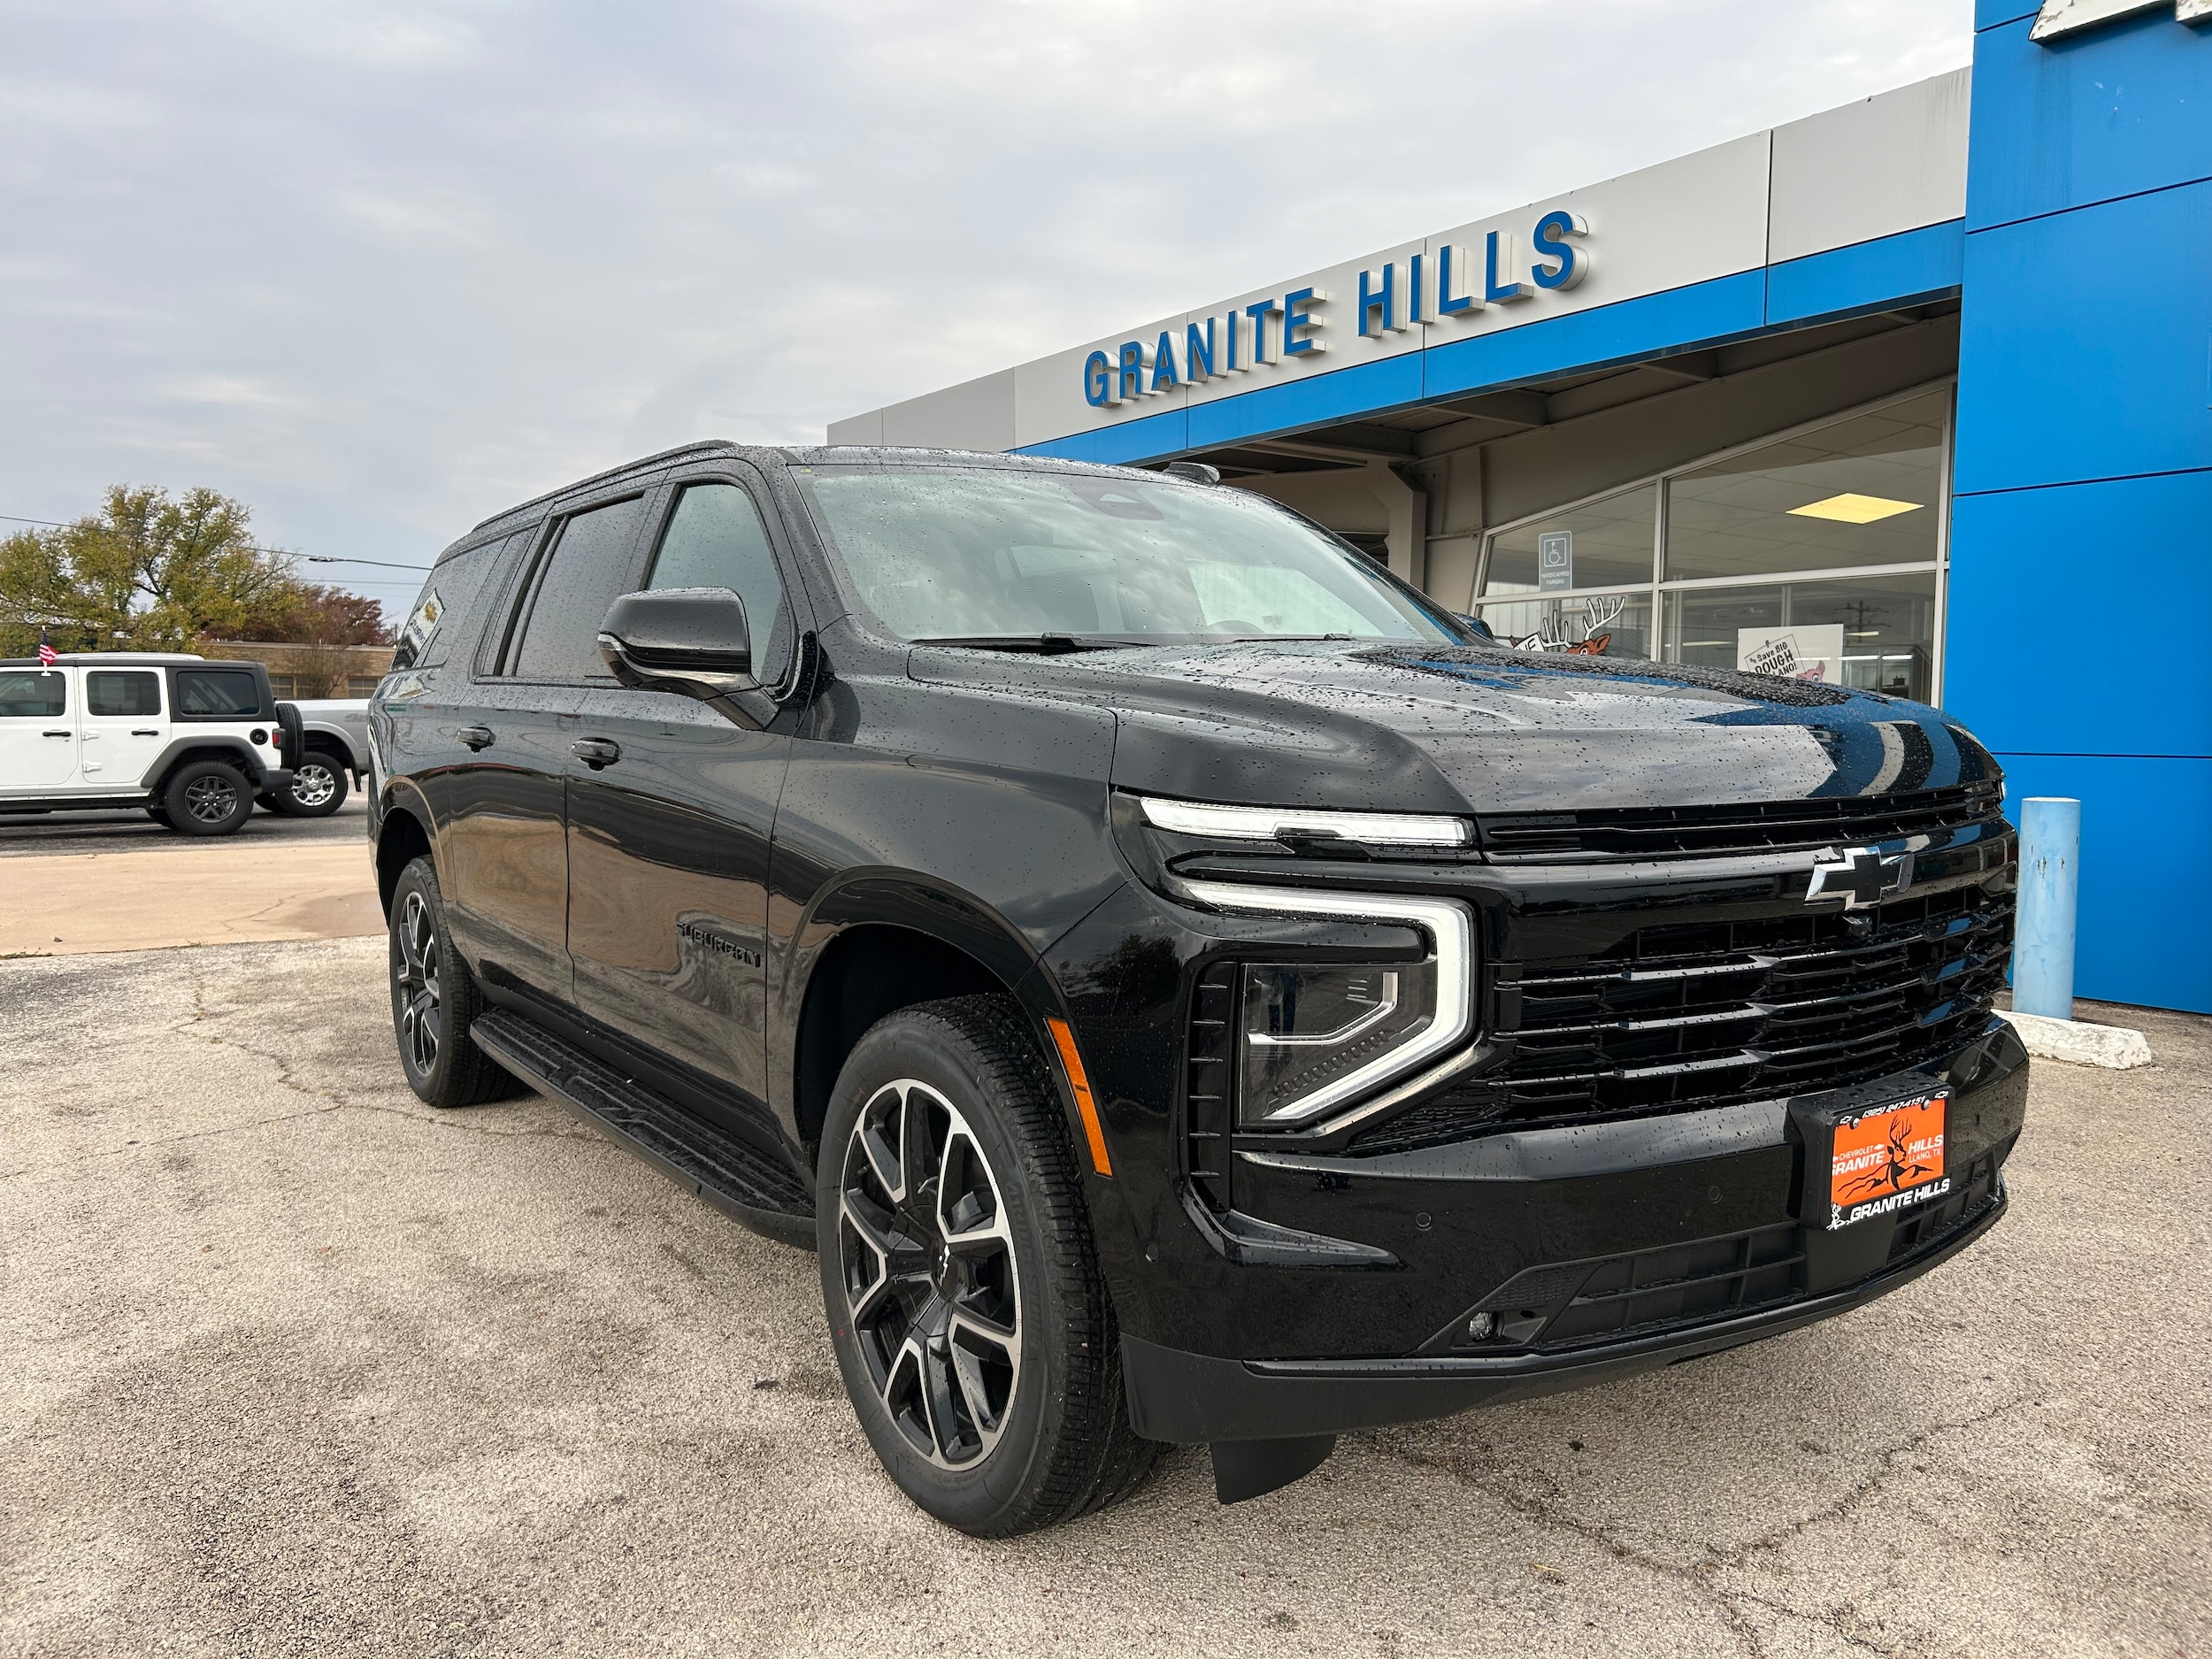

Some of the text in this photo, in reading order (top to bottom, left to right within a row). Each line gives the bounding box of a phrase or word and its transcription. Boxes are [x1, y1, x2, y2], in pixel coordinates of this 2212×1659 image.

[1084, 211, 1584, 409] GRANITE HILLS
[1755, 649, 1793, 673] DOUGH
[1757, 649, 1774, 662] Save
[1862, 1095, 1925, 1118] (325) 247-4151
[1839, 1145, 1873, 1161] CHEVROLET
[1908, 1134, 1944, 1155] HILLS
[1909, 1151, 1931, 1164] LLANO,
[1850, 1178, 1950, 1222] GRANITE HILLS
